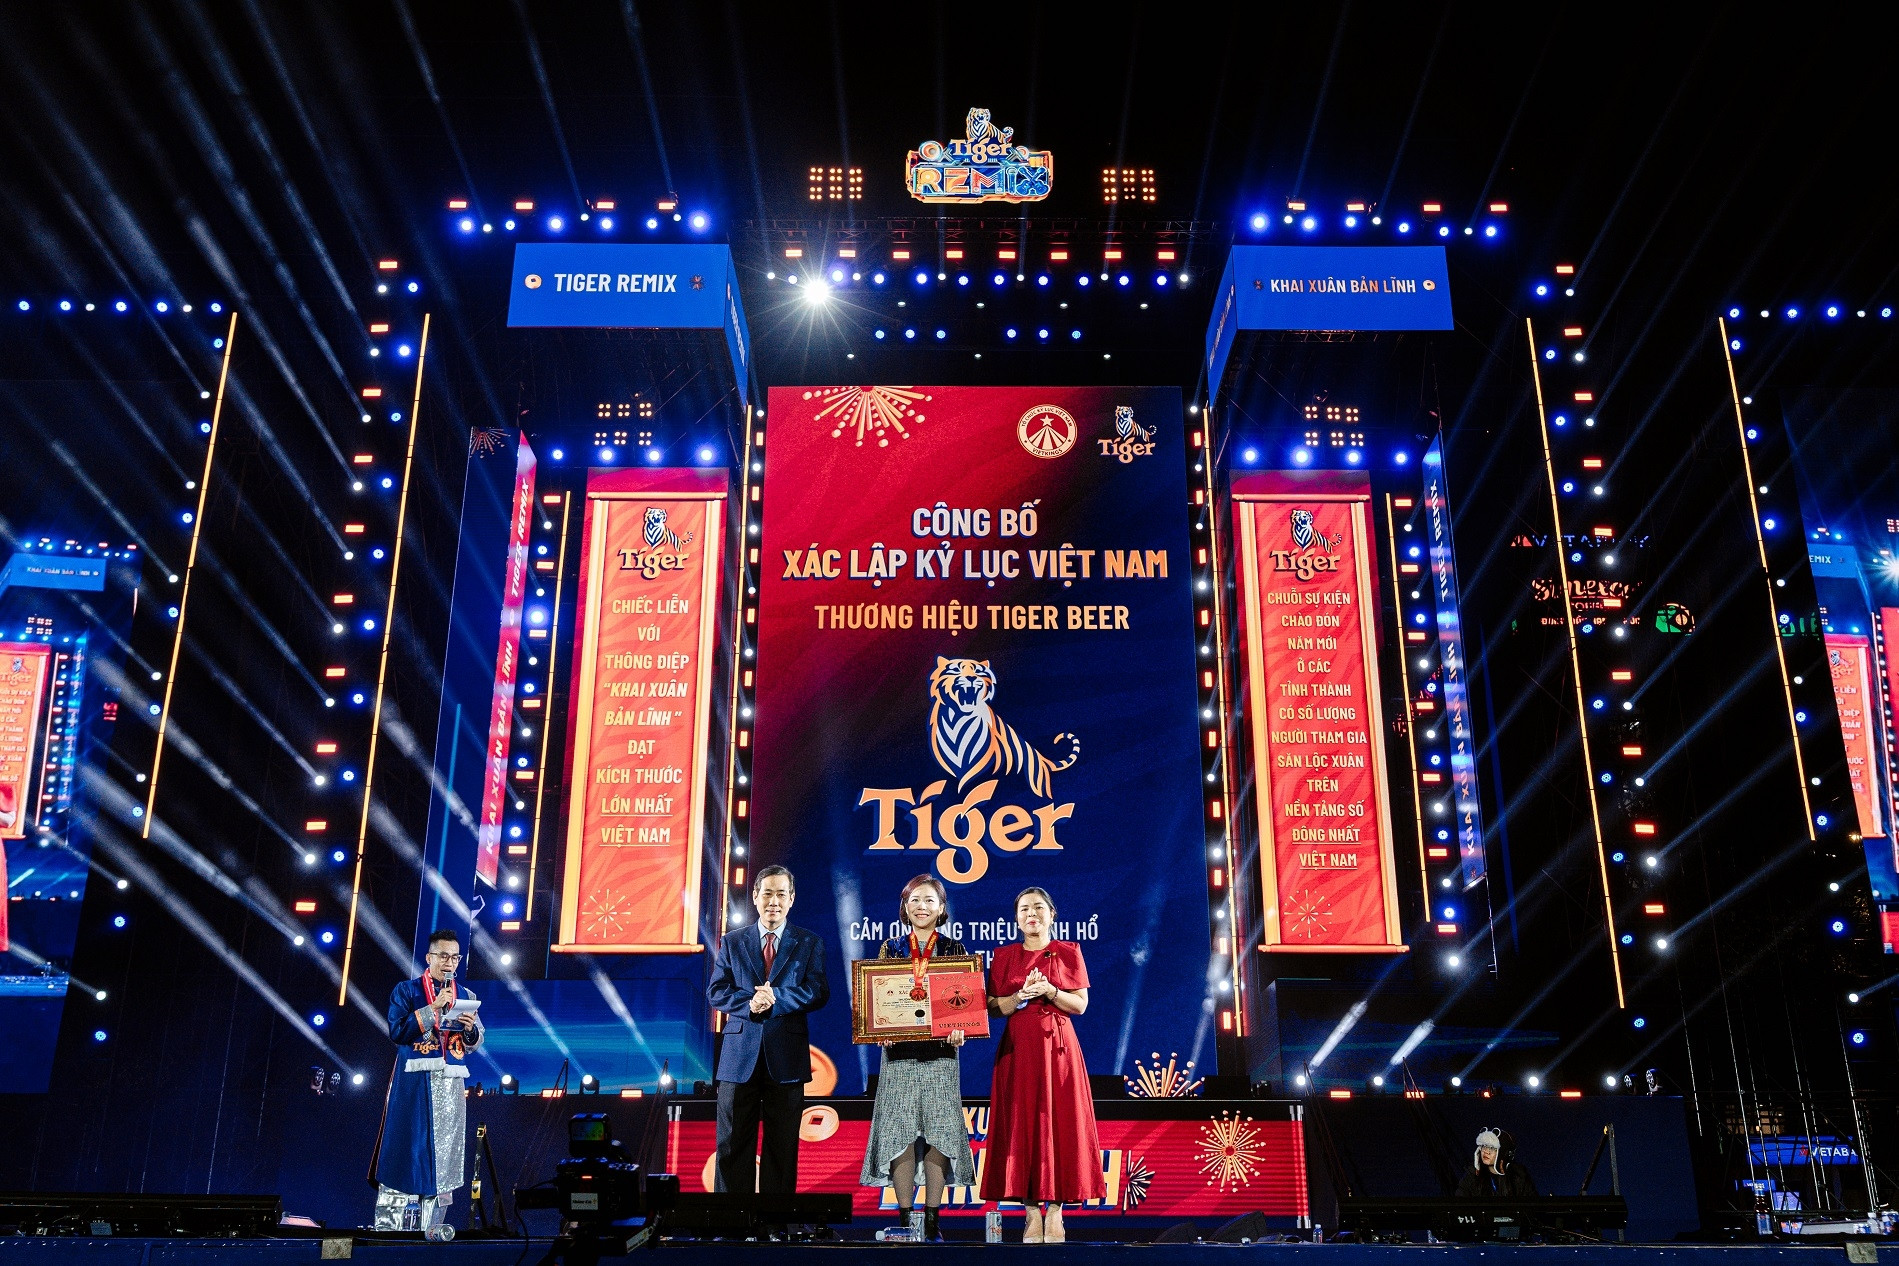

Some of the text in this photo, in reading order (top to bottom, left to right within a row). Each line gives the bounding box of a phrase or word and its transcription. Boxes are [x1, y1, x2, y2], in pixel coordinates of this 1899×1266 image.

[951, 138, 1012, 163] Tiger
[554, 273, 677, 293] TIGER REMIX
[1270, 275, 1416, 293] KHAI XUÂN BẢN LĨNH
[1097, 437, 1156, 464] Tiger
[912, 499, 1042, 537] CÔNG BỐ
[617, 546, 691, 580] Tiger
[782, 540, 1169, 587] XÁC LẬP KỶ LỤC VIỆT NAM
[1270, 547, 1341, 581] Tiger
[1809, 555, 1831, 564] EMIX
[611, 593, 689, 614] CHIẾC LIỄN
[1267, 588, 1351, 608] CHUỖI SỰ KIỆN
[814, 600, 1130, 636] THƯƠNG HIỆU TIGER BEER
[1281, 611, 1340, 627] CHÀO ĐÓN
[637, 623, 660, 641] VỚI
[1287, 634, 1337, 650] NĂM MỚI
[485, 801, 498, 855] KHAI
[512, 541, 523, 597] TIGER
[518, 477, 529, 540] REMIX
[604, 651, 690, 674] THÔNG ĐIỆP
[1297, 656, 1331, 673] Ở CÁC
[1832, 666, 1854, 678] ger
[647, 678, 688, 697] XUÂN
[1280, 680, 1351, 697] TỈNH THÀNH
[603, 706, 634, 726] BẢN
[1278, 703, 1356, 724] CÓ SỐ LƯỢNG
[1271, 728, 1367, 744] NGƯỜI THAM GIA
[627, 739, 655, 759] ĐẠT
[1277, 753, 1364, 771] SĂN LỘC XUÂN
[595, 764, 683, 784] KÍCH THƯỚC
[1306, 776, 1338, 792] TRÊN
[601, 793, 673, 813] LỚN NHẤT
[1285, 799, 1365, 817] NỀN TẢNG SỐ
[601, 824, 671, 848] VIỆT NAM
[858, 779, 1075, 884] Tiger
[1292, 824, 1360, 841] ĐÔNG NHẤT
[1299, 850, 1357, 870] VIỆT NAM
[850, 917, 886, 941] CẢM
[889, 919, 912, 940] ƠN
[968, 917, 1018, 944] TRIỆU
[1076, 914, 1099, 941] HỔ
[413, 1041, 440, 1055] Tiger
